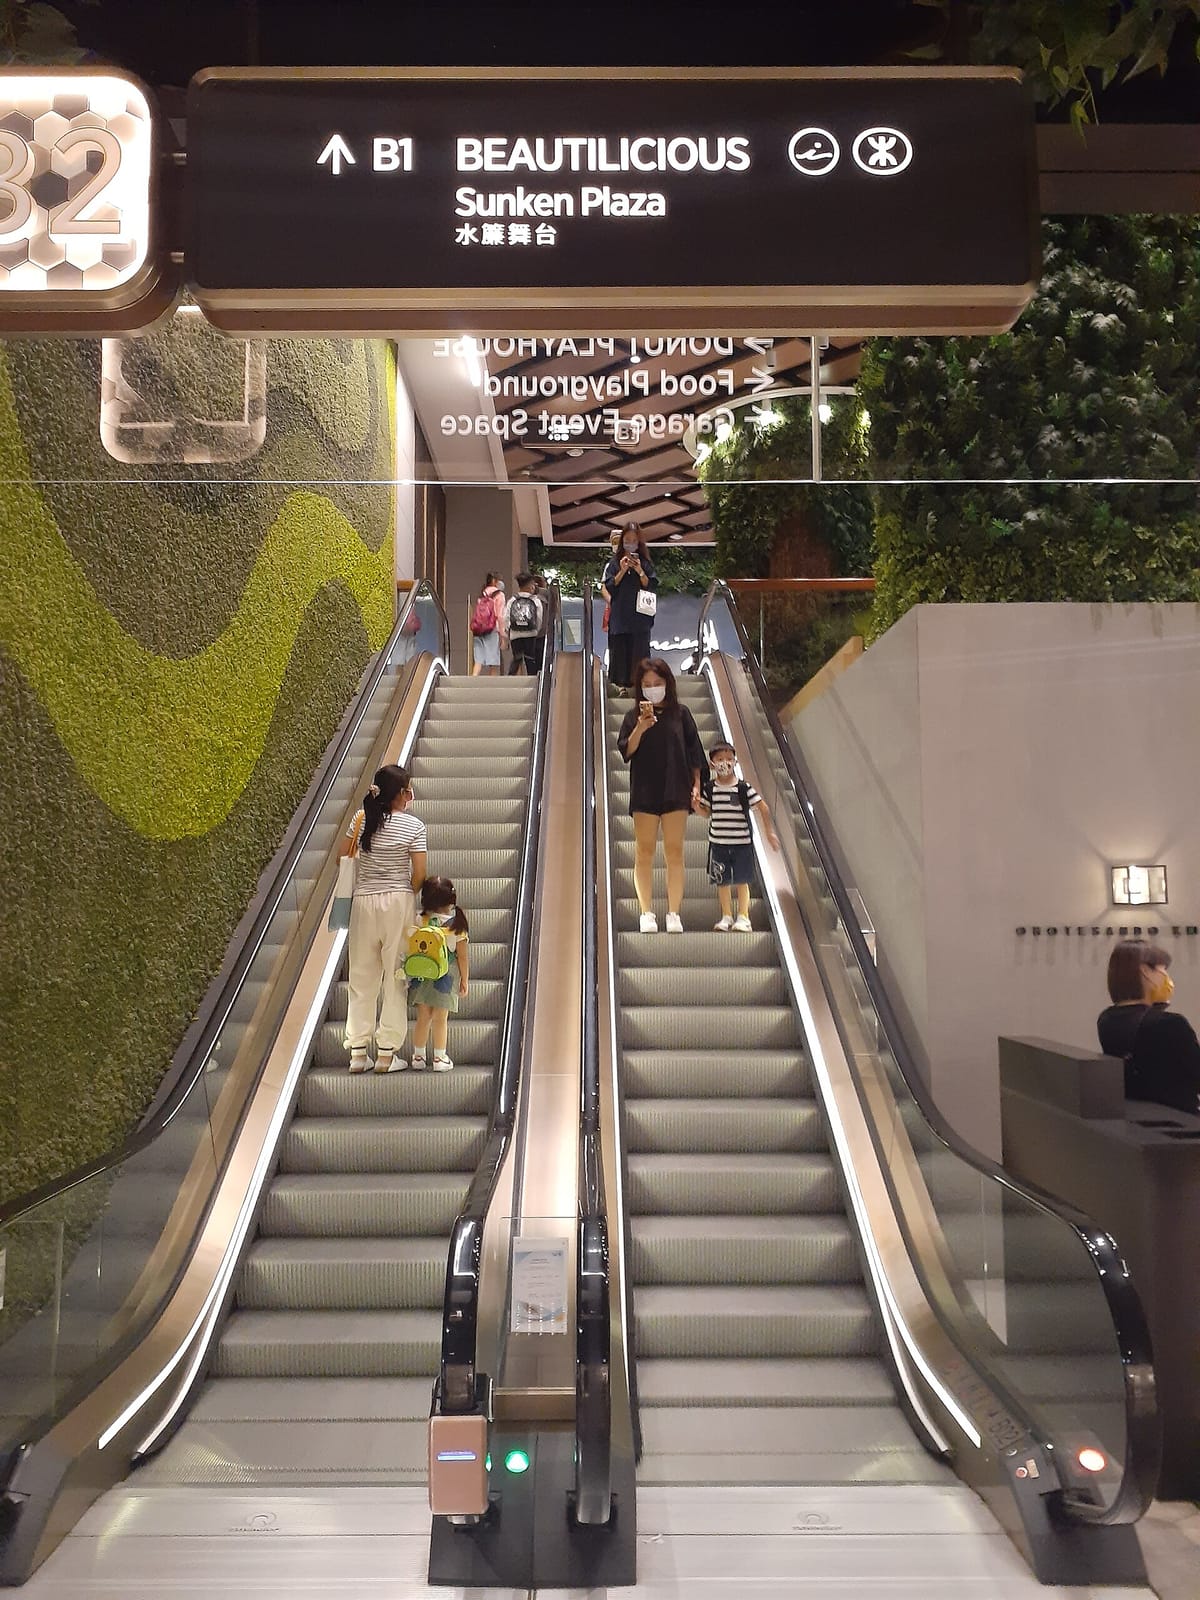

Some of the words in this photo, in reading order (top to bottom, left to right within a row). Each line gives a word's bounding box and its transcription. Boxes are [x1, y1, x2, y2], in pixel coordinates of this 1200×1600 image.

[373, 137, 413, 172] B1
[456, 136, 751, 172] BEAUTILICIOUS
[455, 186, 574, 217] Sunken
[581, 186, 667, 218] Plaza
[455, 223, 557, 247] 水簾舞台
